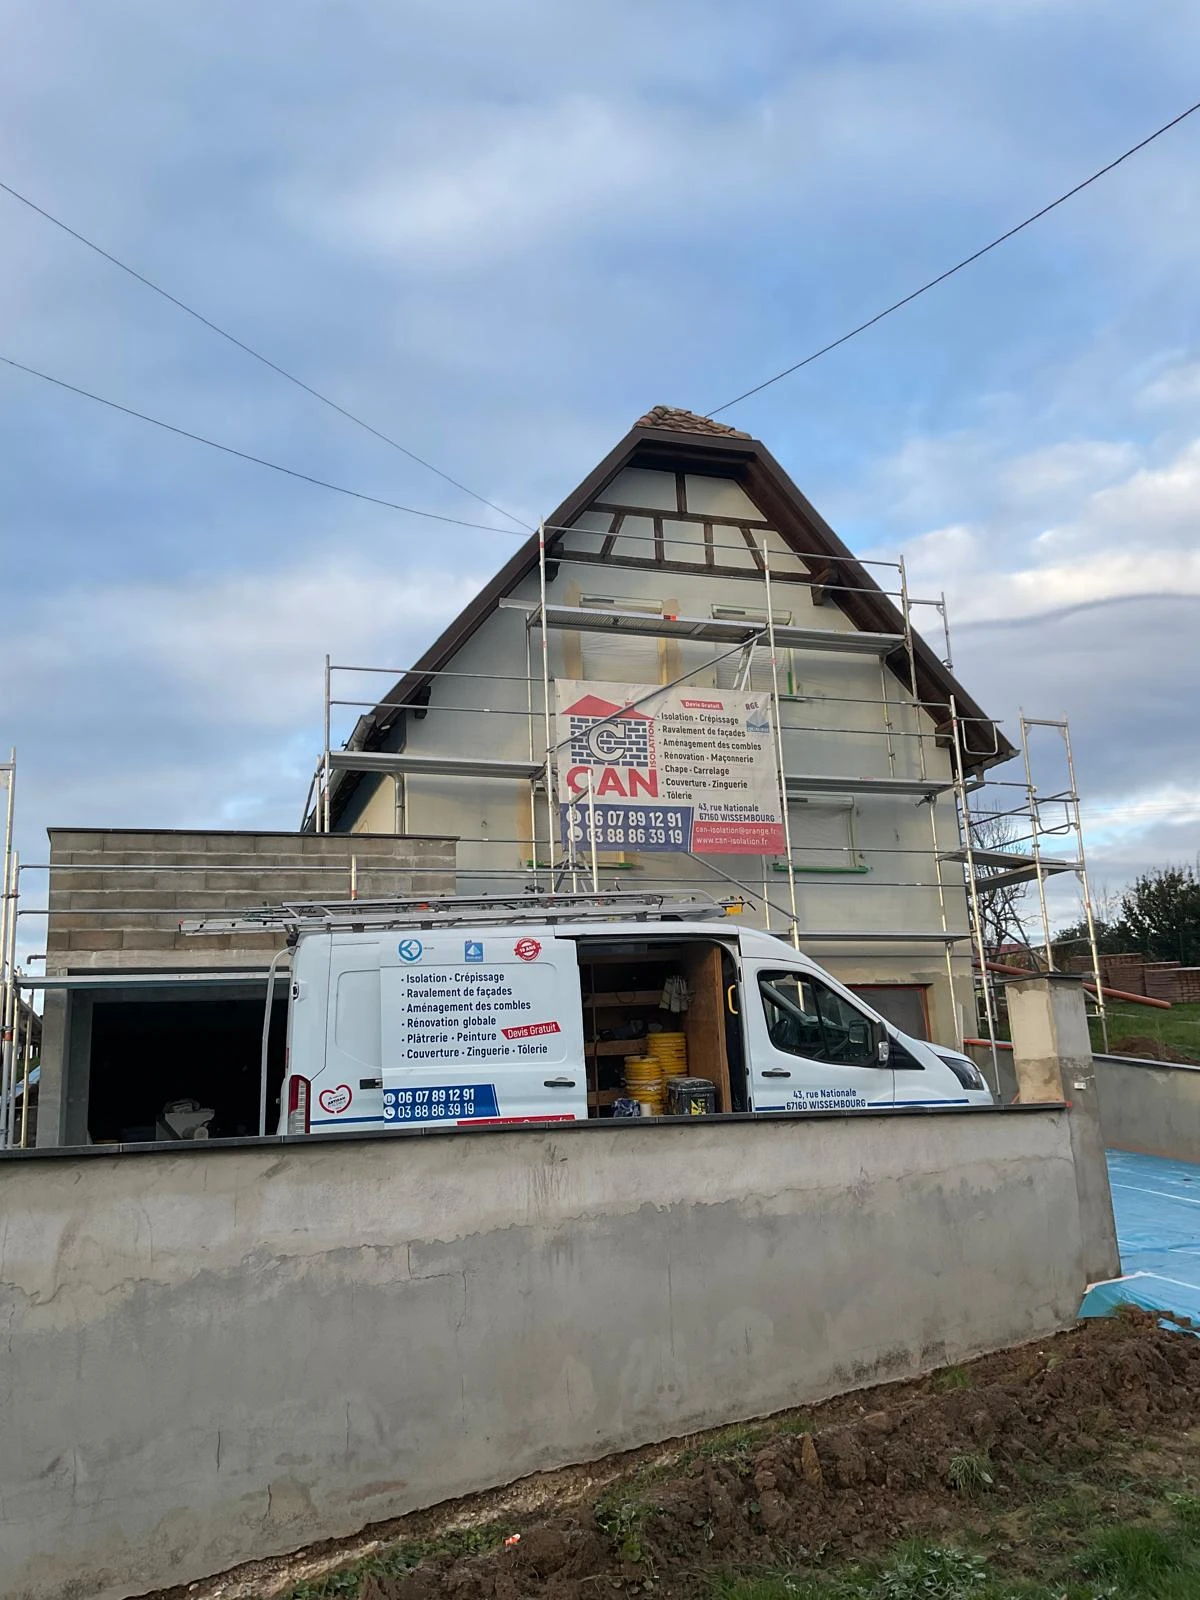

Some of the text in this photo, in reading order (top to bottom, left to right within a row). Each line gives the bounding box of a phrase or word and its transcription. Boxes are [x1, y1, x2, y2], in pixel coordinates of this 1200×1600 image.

[745, 702, 759, 710] RGE
[661, 712, 739, 725] Isolation Crépissage
[663, 726, 705, 736] Ravalement
[707, 727, 716, 736] de
[717, 728, 746, 738] façades
[648, 721, 656, 767] ISOLATION
[664, 739, 761, 750] Aménagement des combles
[664, 751, 754, 764] Rénovation Maçonnerie
[665, 765, 730, 776] Chape Carrelage
[567, 765, 658, 798] CAN
[666, 778, 748, 789] Couverture Zinguerie
[667, 790, 692, 799] Tôlerie
[698, 803, 708, 811] 43,
[608, 811, 624, 825] 07
[629, 812, 645, 826] 89
[649, 813, 666, 826] 12
[668, 813, 682, 826] 91
[720, 814, 775, 822] WISSEMBOURG
[608, 829, 624, 843] 88
[629, 829, 645, 843] 86
[649, 830, 665, 842] 39
[668, 830, 683, 843] 19
[696, 827, 776, 835] can-isolation@orange.fr
[406, 972, 505, 983] Isolation Crépissage
[407, 986, 512, 998] Ravalement de façades
[407, 1001, 531, 1013] Aménagement des combles
[407, 1016, 496, 1027] Rénovation globale
[508, 1024, 556, 1038] Devis Gratuit
[407, 1032, 497, 1043] Plâtrerie Peinture
[407, 1044, 548, 1059] Couverture Zinguerie Tôlerie
[398, 1088, 474, 1103] 06 07 89 12 91
[792, 1089, 804, 1099] 43,
[820, 1088, 857, 1098] Nationale
[398, 1103, 474, 1117] 03 88 86 39 19
[786, 1098, 866, 1110] 67160 WISSEMBOURG
